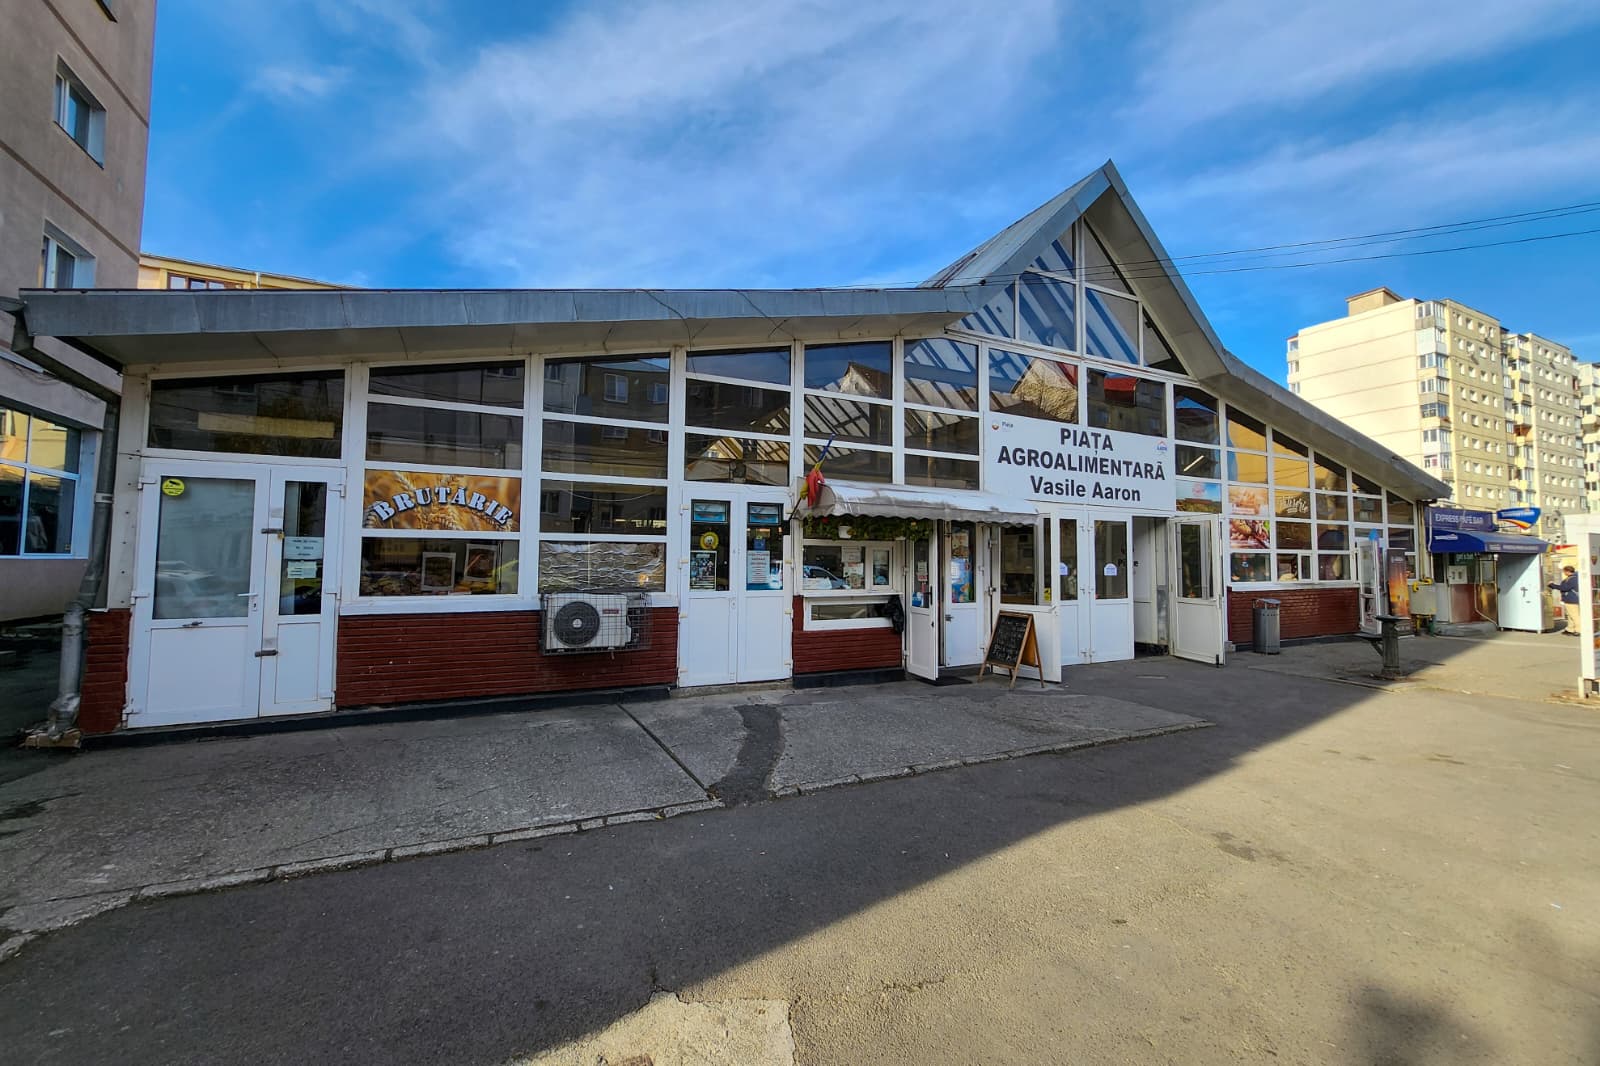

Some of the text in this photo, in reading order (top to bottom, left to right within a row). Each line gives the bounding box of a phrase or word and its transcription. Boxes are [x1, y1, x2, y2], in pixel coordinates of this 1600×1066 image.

[1060, 428, 1113, 455] PIAȚA
[1030, 475, 1141, 501] Vasile Aaron
